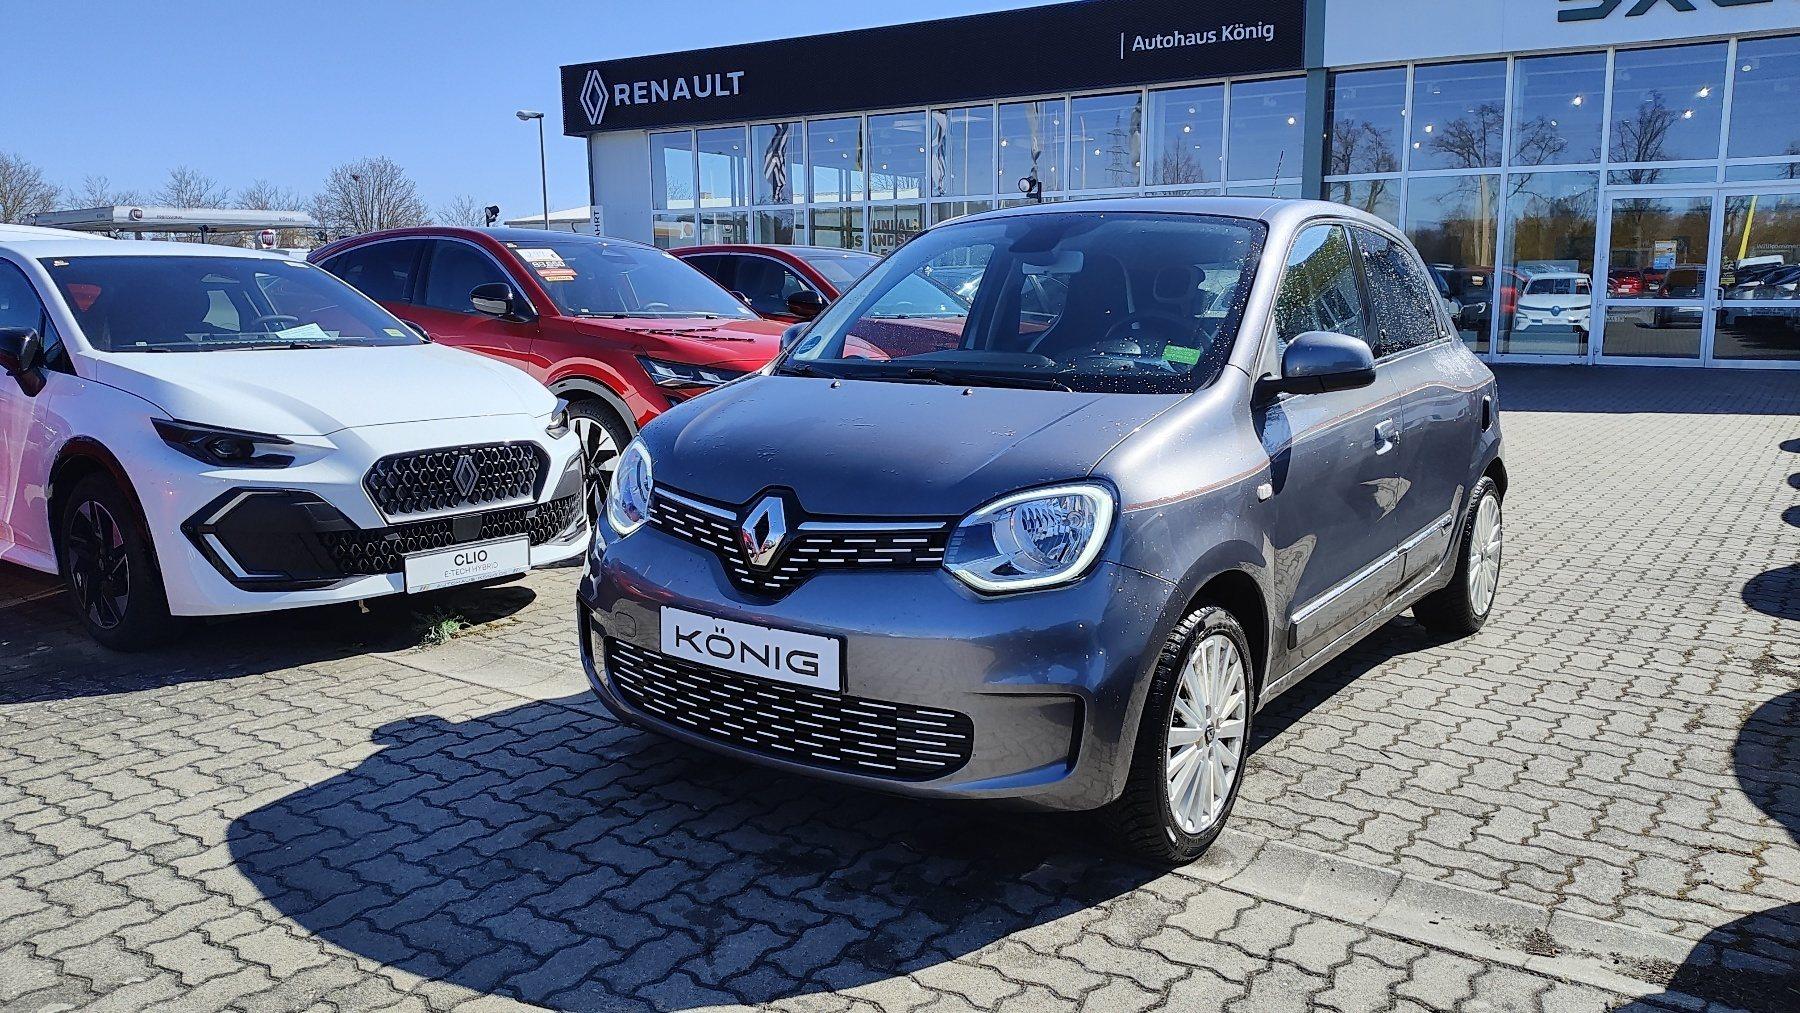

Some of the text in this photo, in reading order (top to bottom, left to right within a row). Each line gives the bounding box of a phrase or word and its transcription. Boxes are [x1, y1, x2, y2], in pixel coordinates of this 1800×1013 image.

[1132, 21, 1275, 52] Autohaus König
[613, 71, 745, 107] RENAULT
[444, 566, 470, 578] E-TECH
[454, 550, 488, 566] CLIO
[675, 625, 819, 678] KÖNIG
